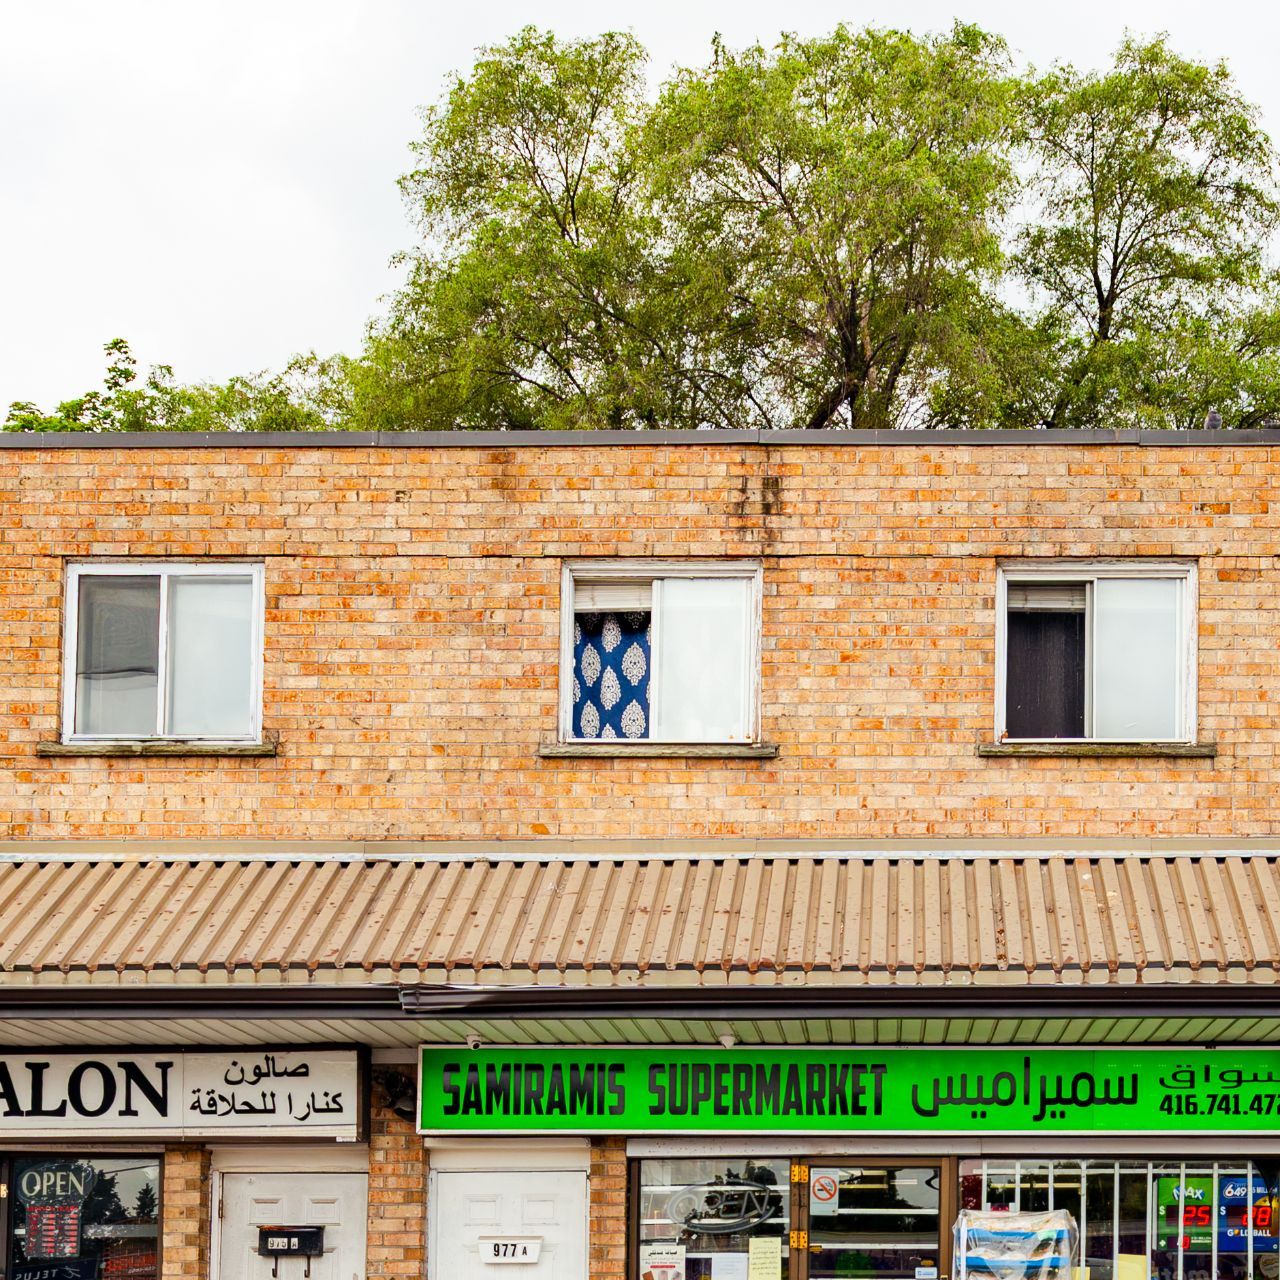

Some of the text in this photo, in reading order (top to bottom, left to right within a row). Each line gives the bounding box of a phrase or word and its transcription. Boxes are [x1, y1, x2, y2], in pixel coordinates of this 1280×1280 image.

[224, 1055, 310, 1085] صالون
[442, 1062, 887, 1117] SAMIRAMIS SUPERMARKET
[912, 1056, 1139, 1122] سميراميس
[189, 1089, 344, 1122] كنارا للحلاقة
[21, 1171, 85, 1197] OPEN
[673, 1190, 769, 1220] OPEN
[1158, 1205, 1210, 1226] $ 25
[1220, 1205, 1226, 1215] $
[1252, 1229, 1271, 1237] BALL
[493, 1243, 528, 1257] 977 A
